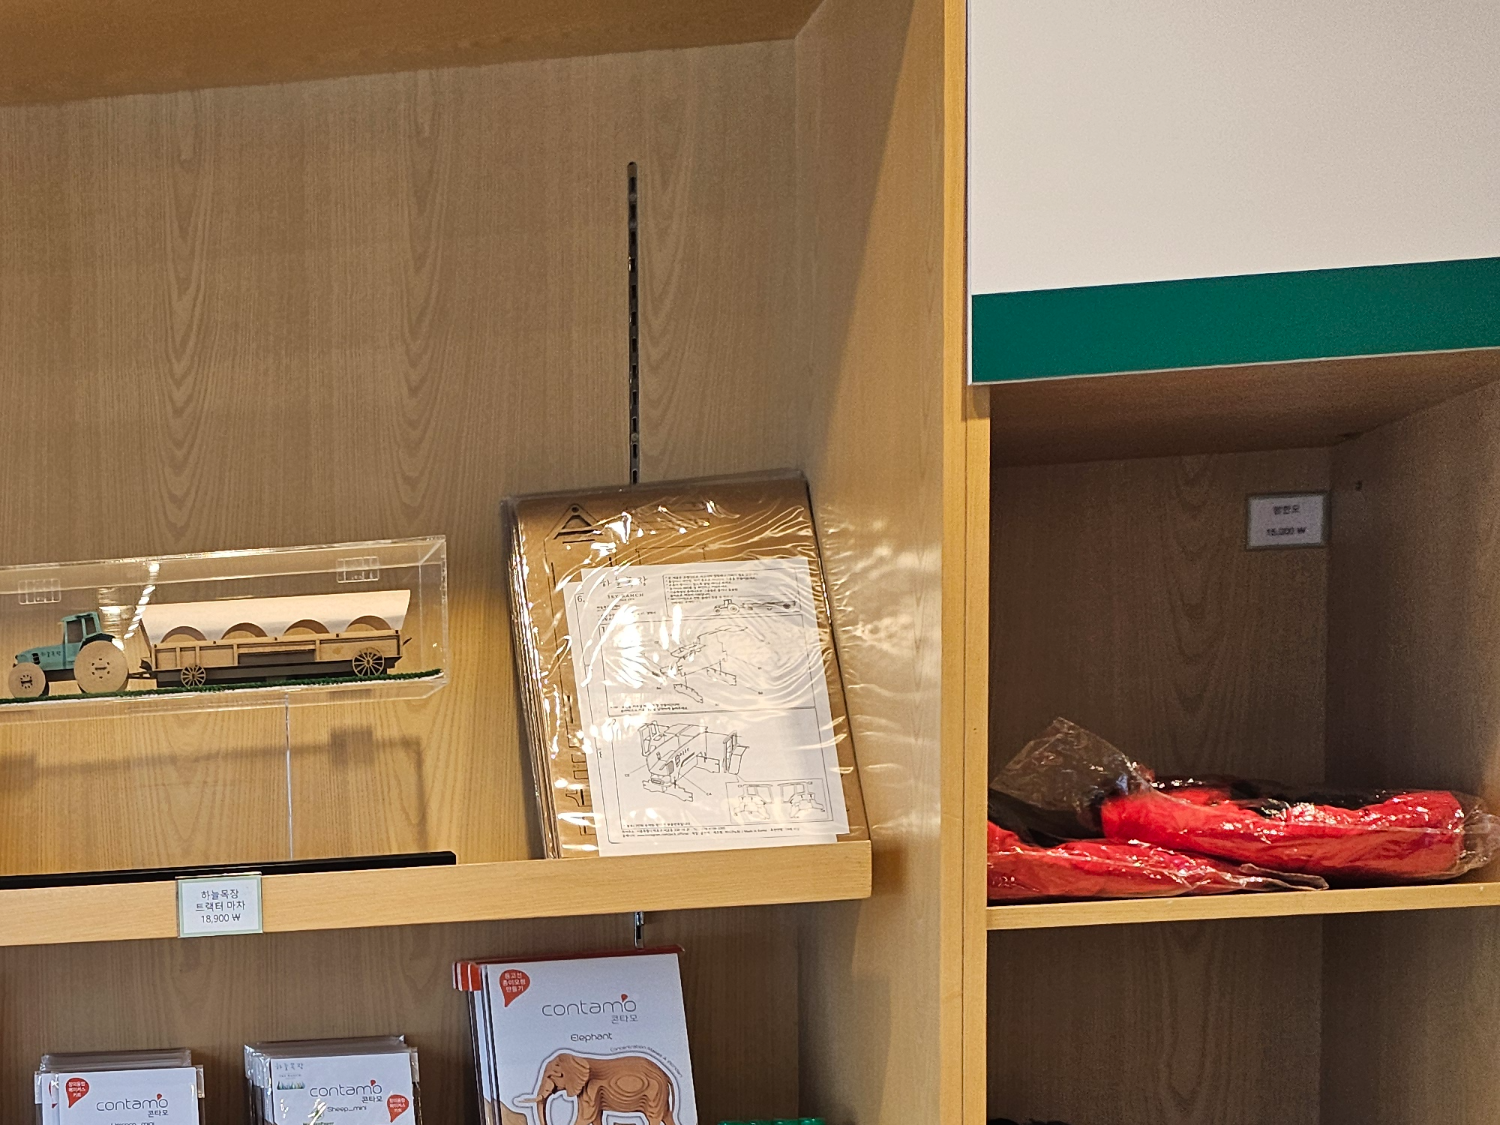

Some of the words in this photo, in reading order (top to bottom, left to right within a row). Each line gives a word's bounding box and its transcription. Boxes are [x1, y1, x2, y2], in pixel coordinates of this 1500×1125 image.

[201, 888, 239, 900] 하늘목장
[195, 901, 223, 912] 트랙터
[226, 900, 246, 911] 마차
[201, 913, 230, 924] 18,900
[502, 978, 526, 986] 종이모형
[505, 985, 525, 993] 만들기
[541, 1000, 637, 1017] contamo
[611, 1014, 638, 1024] 콘타모
[570, 1032, 613, 1043] Elephant
[309, 1084, 383, 1098] contamo
[96, 1097, 169, 1112] contamo
[362, 1095, 383, 1104] 콘타모
[148, 1109, 169, 1118] 콘타모
[327, 1105, 367, 1113] Sheep_mini
